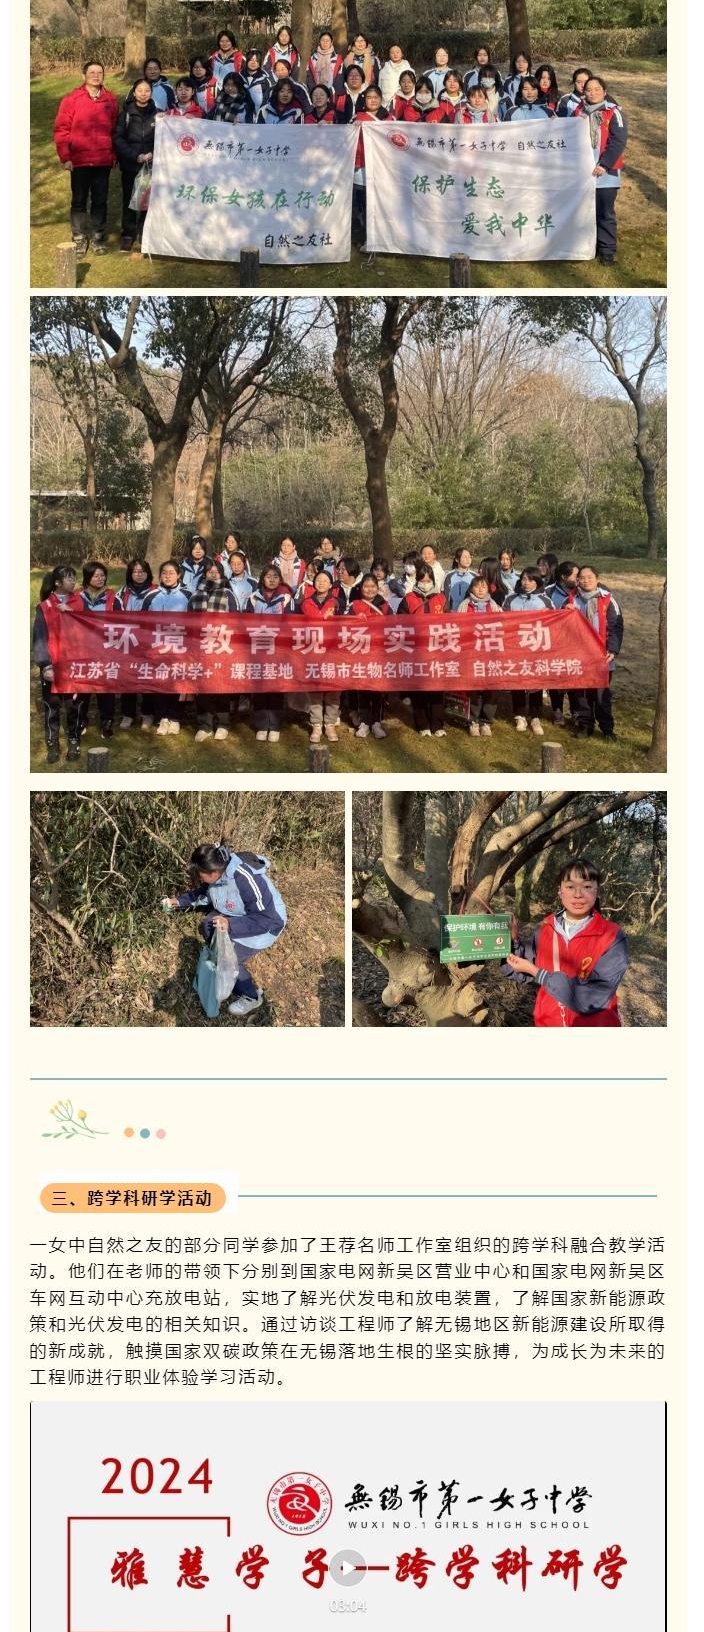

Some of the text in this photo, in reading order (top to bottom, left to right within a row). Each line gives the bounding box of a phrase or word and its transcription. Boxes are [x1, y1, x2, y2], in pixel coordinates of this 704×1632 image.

[176, 183, 335, 210] 环保女孩在行动
[412, 174, 505, 199] 保护生态
[461, 211, 555, 239] 爱我中华
[264, 233, 333, 249] 自然之友社
[103, 621, 552, 655] 环境教育现场实践活动
[473, 658, 583, 677] 自然之友科学院
[52, 1190, 211, 1206] 三、跨学科研学活动
[101, 1457, 213, 1495] 2024
[348, 1520, 385, 1530] WUXI
[435, 1520, 479, 1530] GIRLS
[487, 1520, 523, 1530] HIGH
[530, 1520, 590, 1530] SCHOOL
